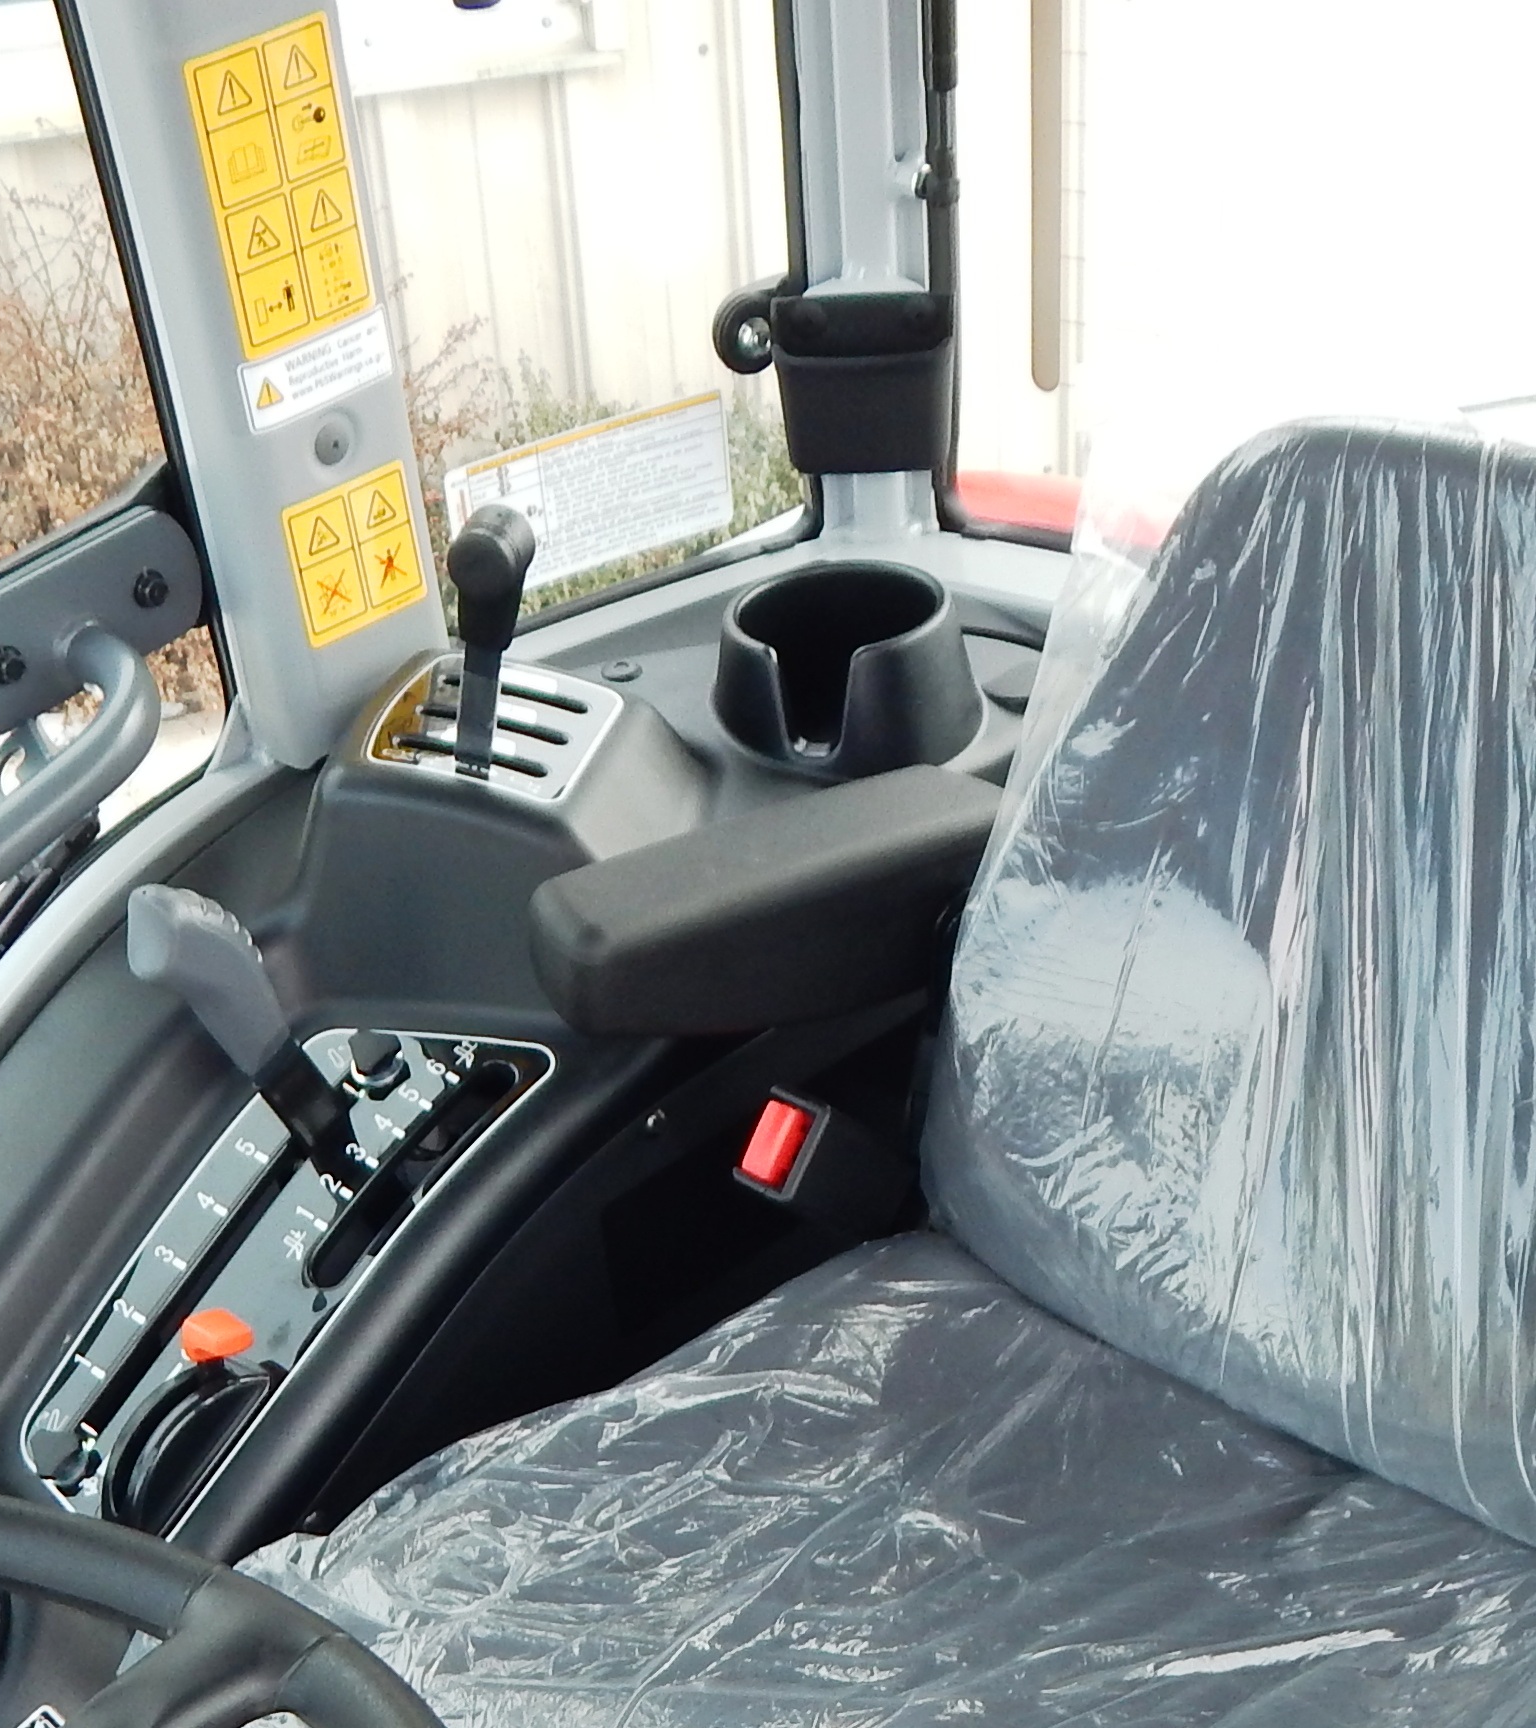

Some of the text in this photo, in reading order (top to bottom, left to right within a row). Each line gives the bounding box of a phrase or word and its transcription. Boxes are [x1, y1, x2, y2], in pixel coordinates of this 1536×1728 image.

[296, 1058, 446, 1221] 1 2 3 4 5 6
[73, 1137, 256, 1369] 1 2 3 4 5
